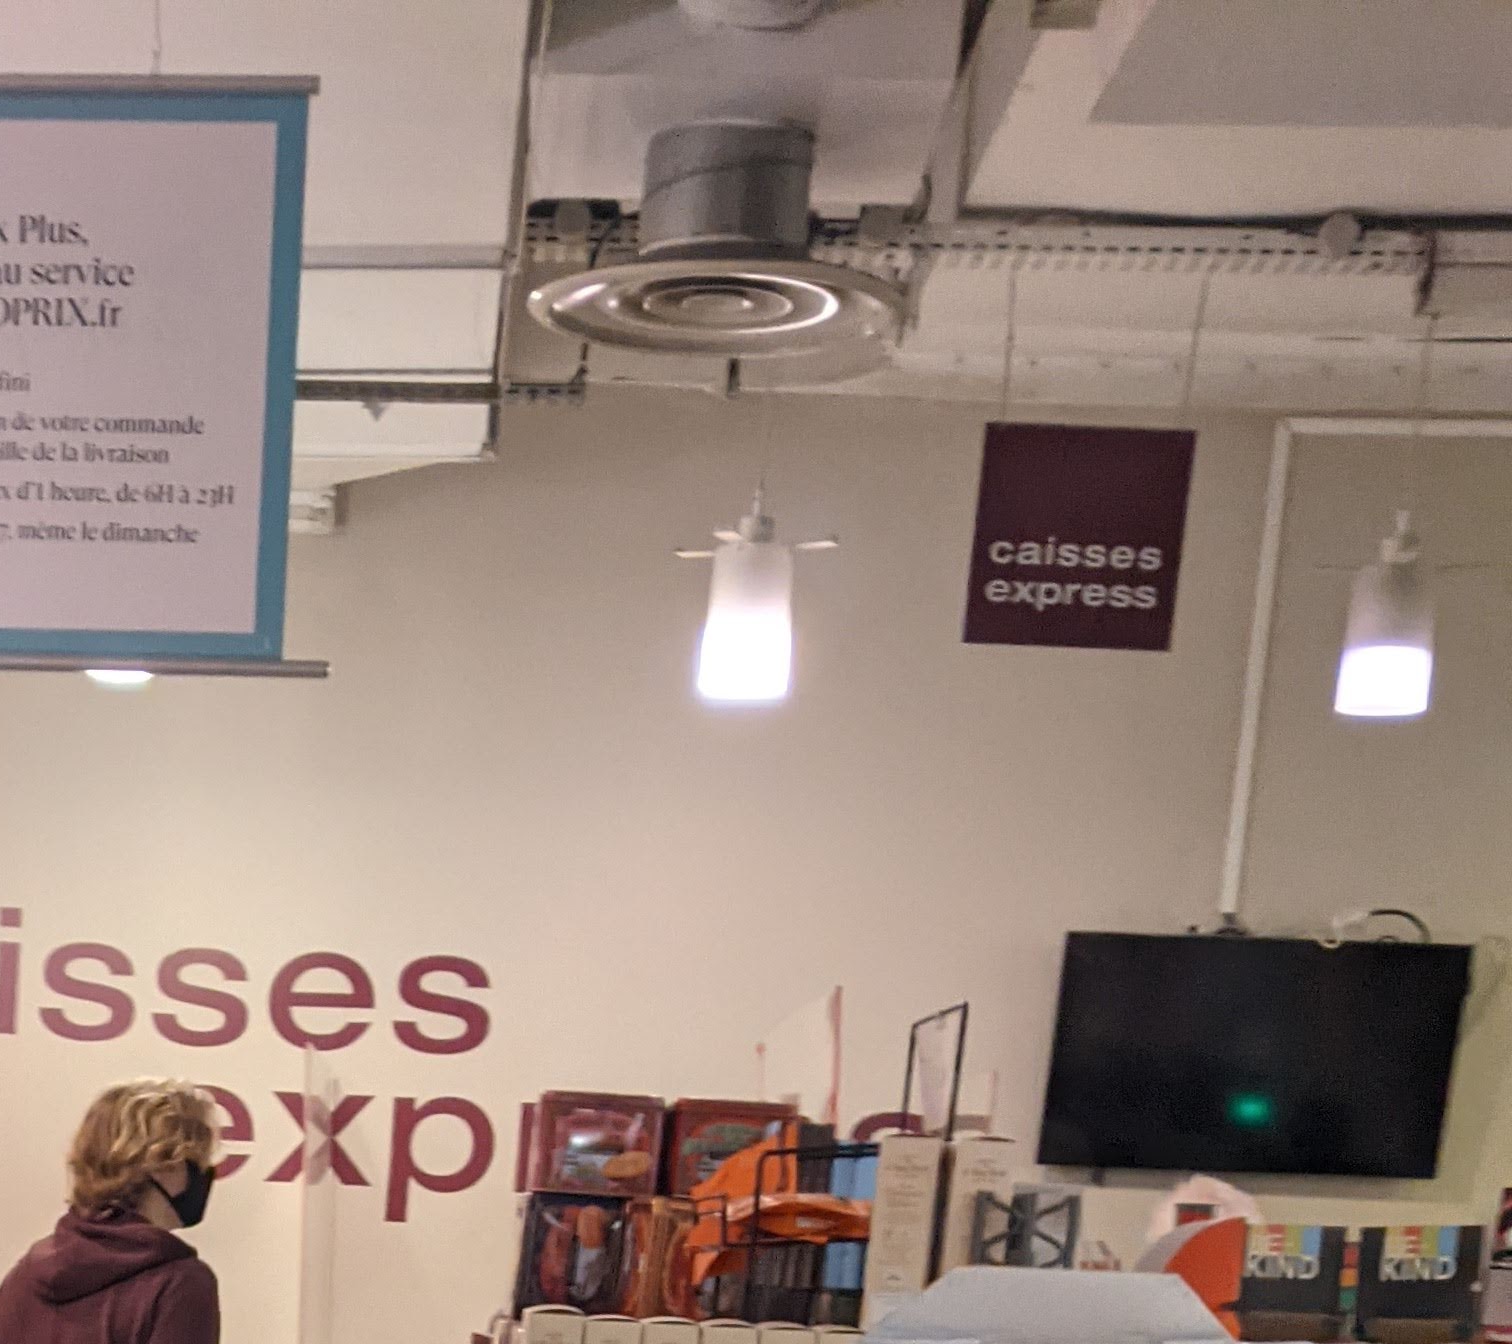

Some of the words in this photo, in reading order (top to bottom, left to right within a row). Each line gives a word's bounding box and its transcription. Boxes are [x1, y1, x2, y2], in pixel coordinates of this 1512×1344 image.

[29, 257, 135, 287] service
[11, 411, 36, 431] de
[40, 415, 89, 432] votre
[94, 415, 205, 434] commande
[32, 442, 57, 461] de
[61, 441, 79, 462] la
[84, 443, 170, 464] livraison
[116, 482, 140, 502] de
[82, 521, 99, 541] le
[102, 522, 201, 543] dimanche
[988, 536, 1164, 571] caisses
[984, 578, 1158, 612] express
